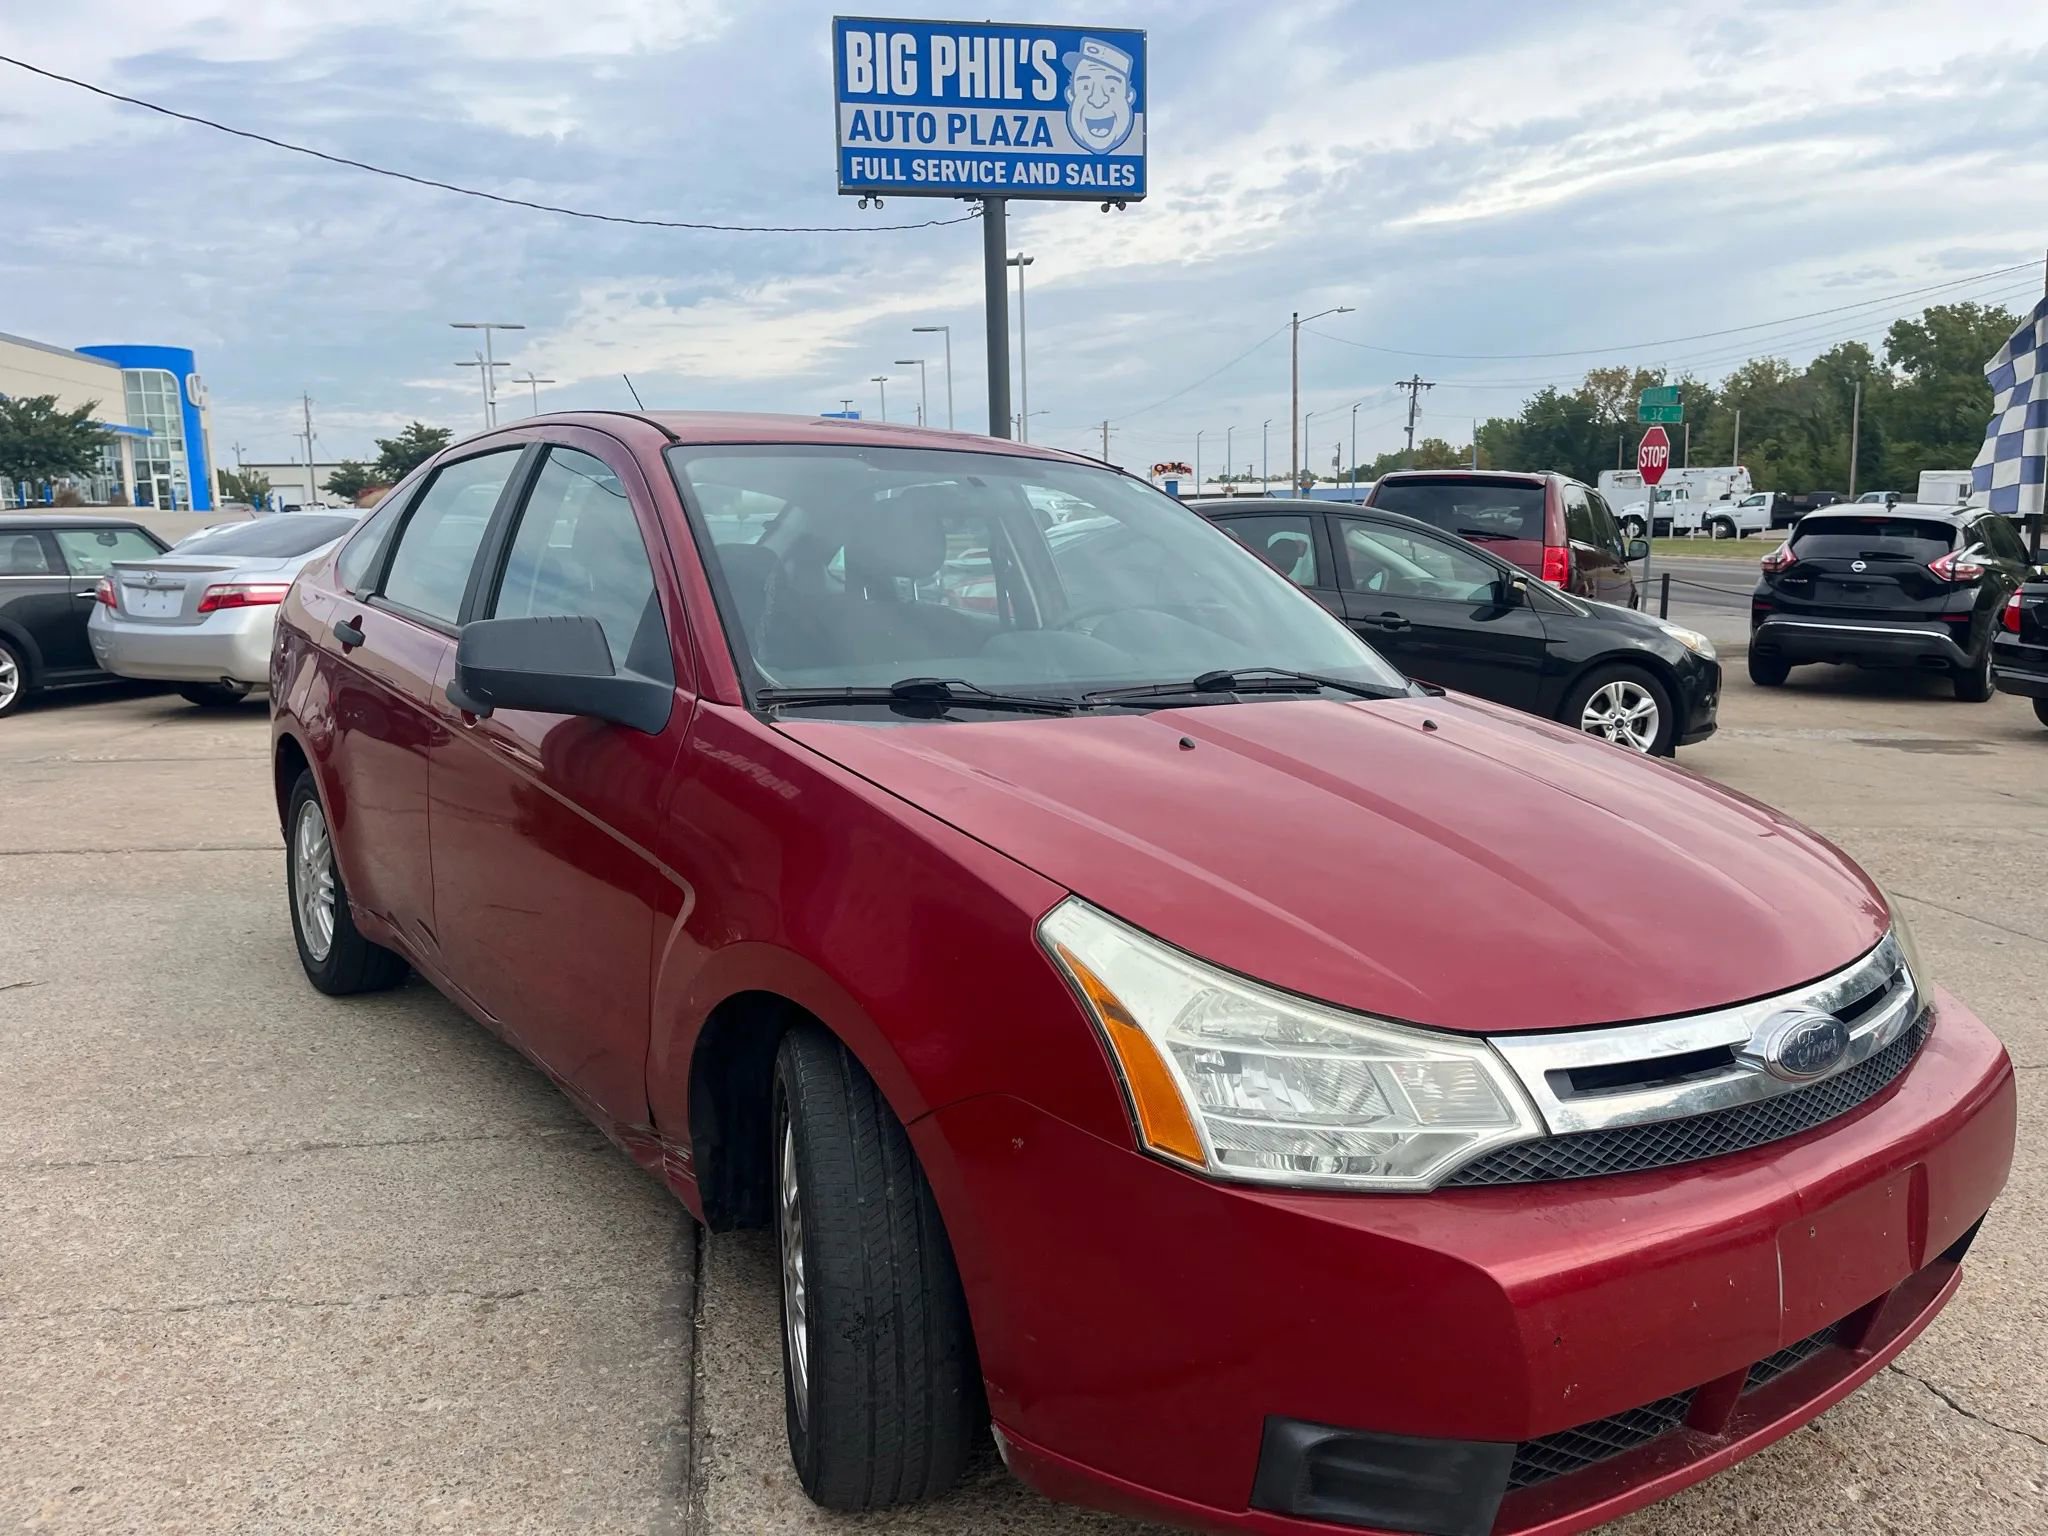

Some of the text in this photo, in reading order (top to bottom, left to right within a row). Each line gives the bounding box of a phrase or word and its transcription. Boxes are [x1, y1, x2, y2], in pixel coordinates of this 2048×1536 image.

[845, 31, 1057, 101] BIG PHIL'S
[848, 109, 1054, 148] AUTO PLAZA
[851, 156, 1136, 187] FULL SERVICE AND SALES
[1640, 446, 1667, 467] STOP
[1797, 1022, 1840, 1067] Ford
